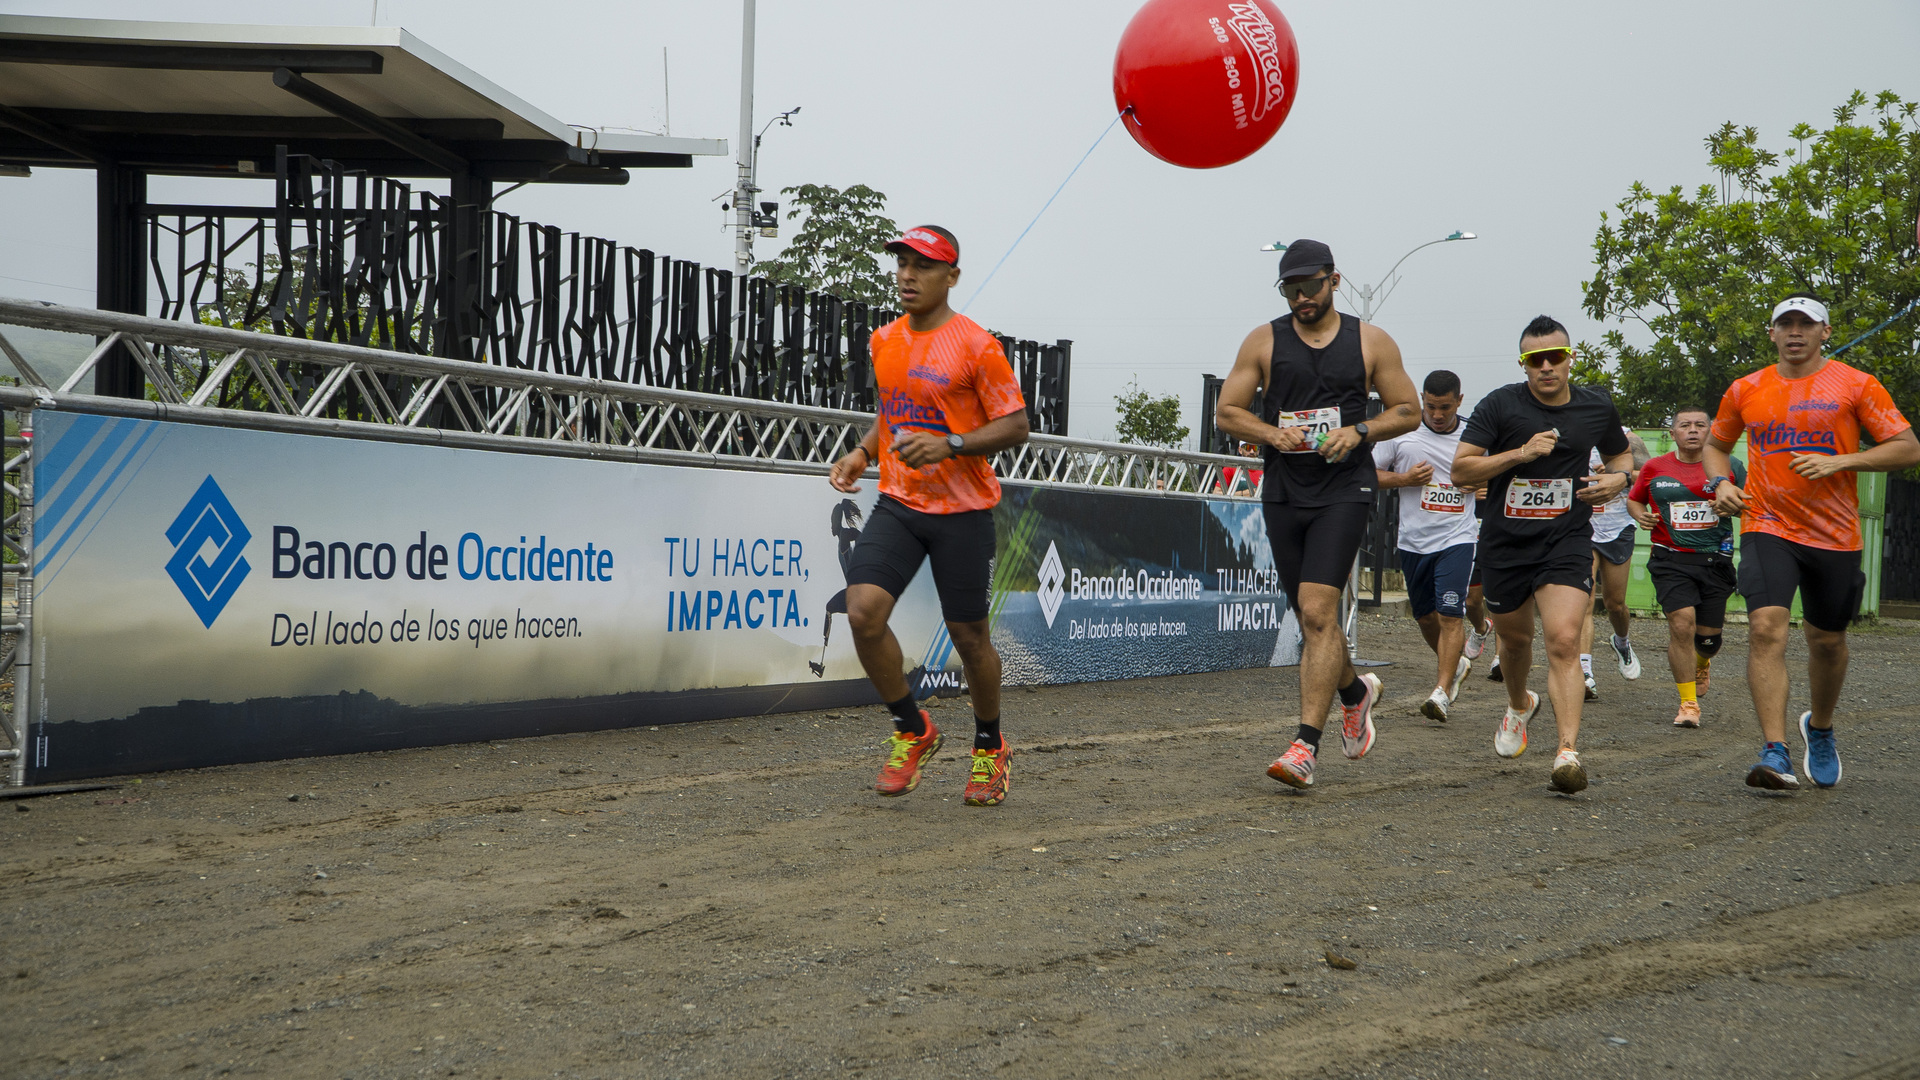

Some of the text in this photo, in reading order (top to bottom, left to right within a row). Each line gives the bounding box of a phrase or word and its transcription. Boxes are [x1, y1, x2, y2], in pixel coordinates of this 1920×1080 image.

[1228, 3, 1285, 111] Muñeca
[1208, 17, 1248, 130] 5:00 5:00 MIN
[892, 387, 907, 401] La
[879, 395, 945, 425] Muñeca
[1750, 426, 1836, 452] Muñeca
[1768, 419, 1786, 432] La
[1429, 491, 1461, 504] 2005
[1521, 492, 1555, 506] 264
[1682, 510, 1707, 521] 497
[272, 525, 614, 582] Banco de Occidente
[664, 537, 809, 583] TU HACER,
[1070, 568, 1201, 600] Banco de Occidente
[1217, 568, 1281, 599] TU HACER,
[667, 589, 809, 632] IMPACTA.
[1218, 603, 1281, 632] IMPACTA.
[271, 608, 582, 649] Del lado de los que hacen.
[1069, 616, 1188, 642] Del lado de los que hacen.
[920, 671, 959, 689] AVAL
